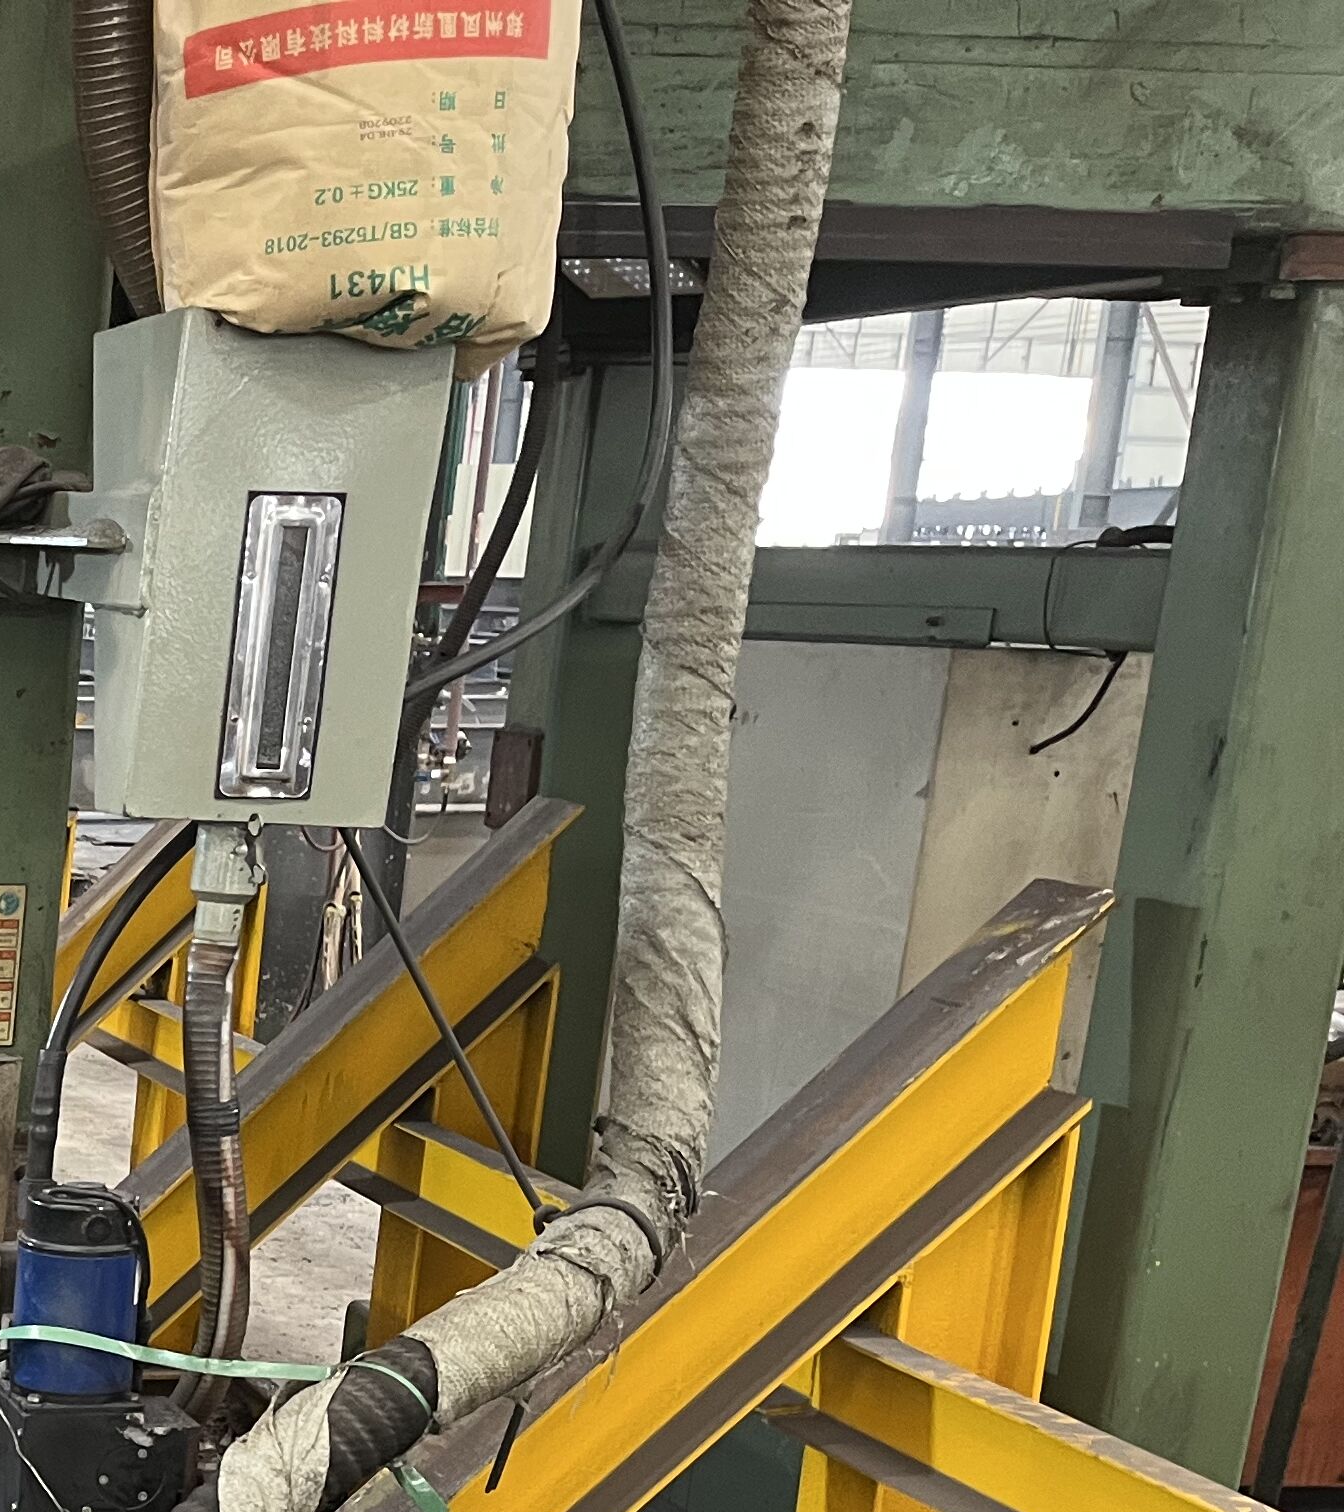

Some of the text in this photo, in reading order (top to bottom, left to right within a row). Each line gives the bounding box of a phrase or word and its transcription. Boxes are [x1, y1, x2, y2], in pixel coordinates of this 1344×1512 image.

[214, 10, 525, 71] 郑州凤凰新材料科技有限公司
[314, 186, 344, 206] 0.2
[367, 179, 419, 201] 25KG
[264, 220, 418, 256] GB/T5293-2018
[328, 263, 431, 301] HJ431
